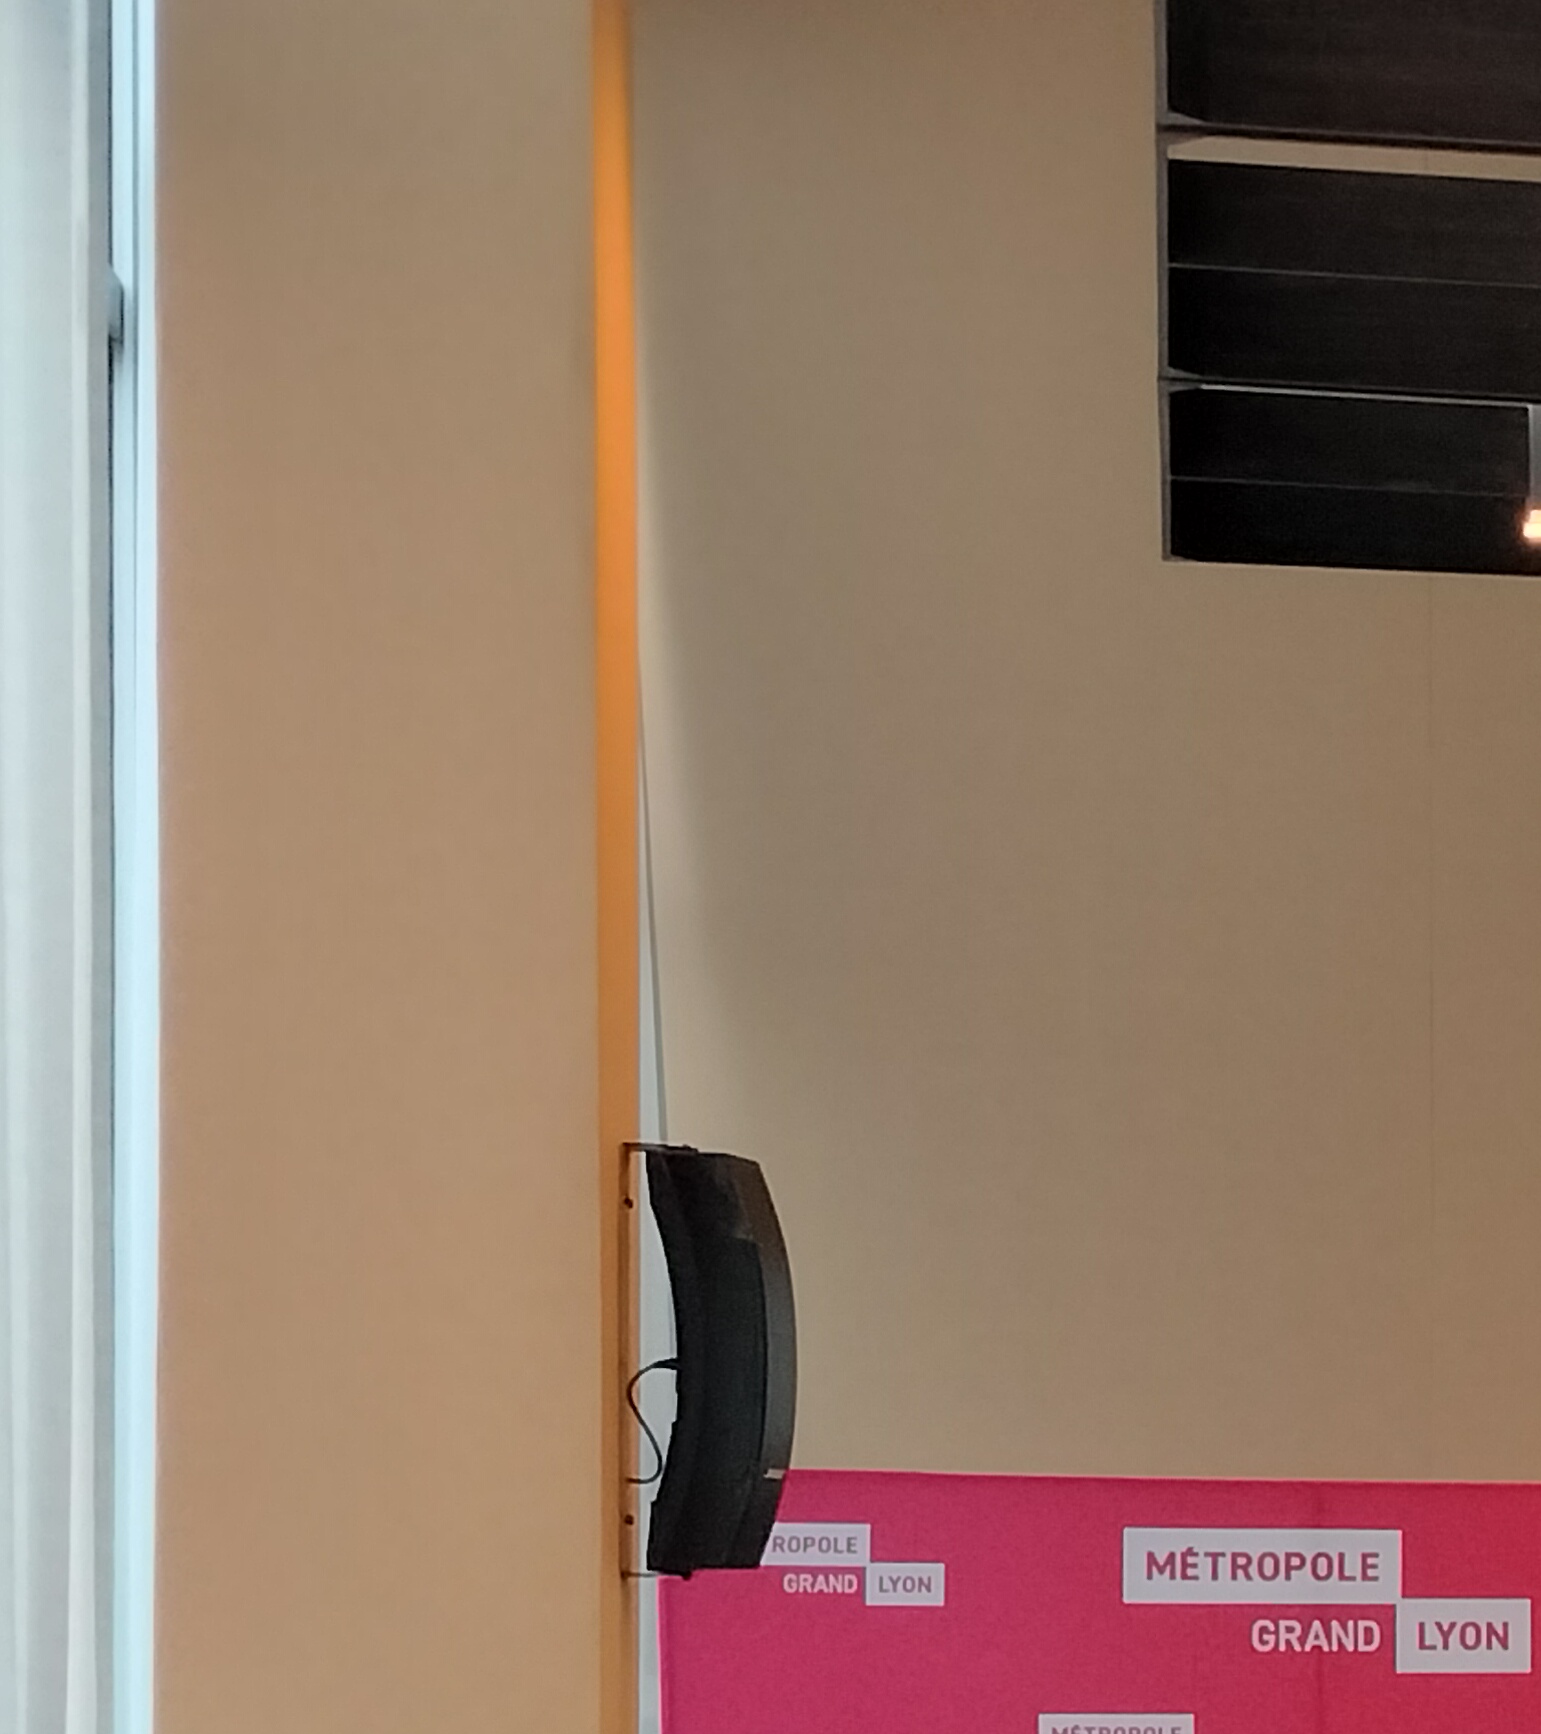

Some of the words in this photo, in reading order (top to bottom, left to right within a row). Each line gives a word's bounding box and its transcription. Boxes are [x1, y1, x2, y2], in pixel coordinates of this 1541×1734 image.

[772, 1534, 859, 1556] ROPOLE
[1147, 1547, 1379, 1581] MÉTROPOLE
[782, 1573, 860, 1595] GRAND
[879, 1576, 931, 1593] LYON
[1252, 1620, 1380, 1652] GRAND
[1419, 1622, 1509, 1650] LYON
